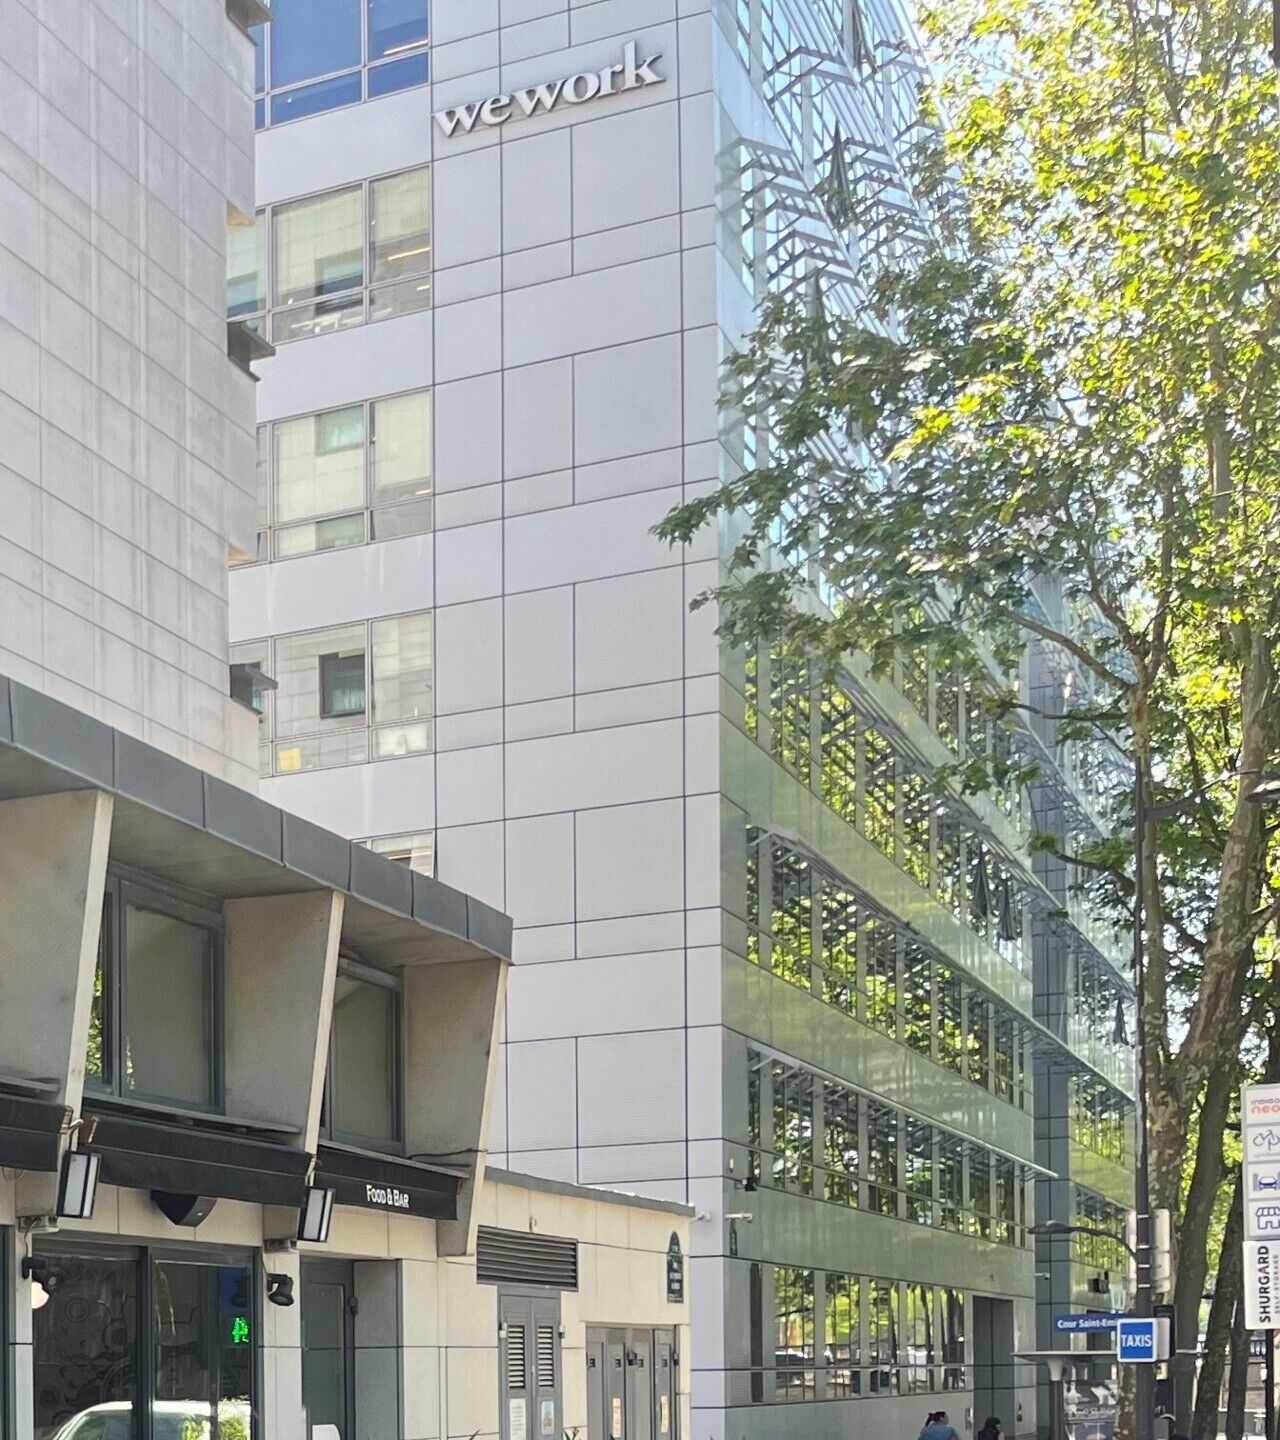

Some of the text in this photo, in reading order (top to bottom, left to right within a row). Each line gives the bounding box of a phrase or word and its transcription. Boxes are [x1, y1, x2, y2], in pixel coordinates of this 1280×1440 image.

[433, 40, 667, 137] wework
[1257, 1245, 1271, 1323] SHURGARD
[1057, 1320, 1077, 1329] Cour
[1121, 1334, 1152, 1347] TAXIS
